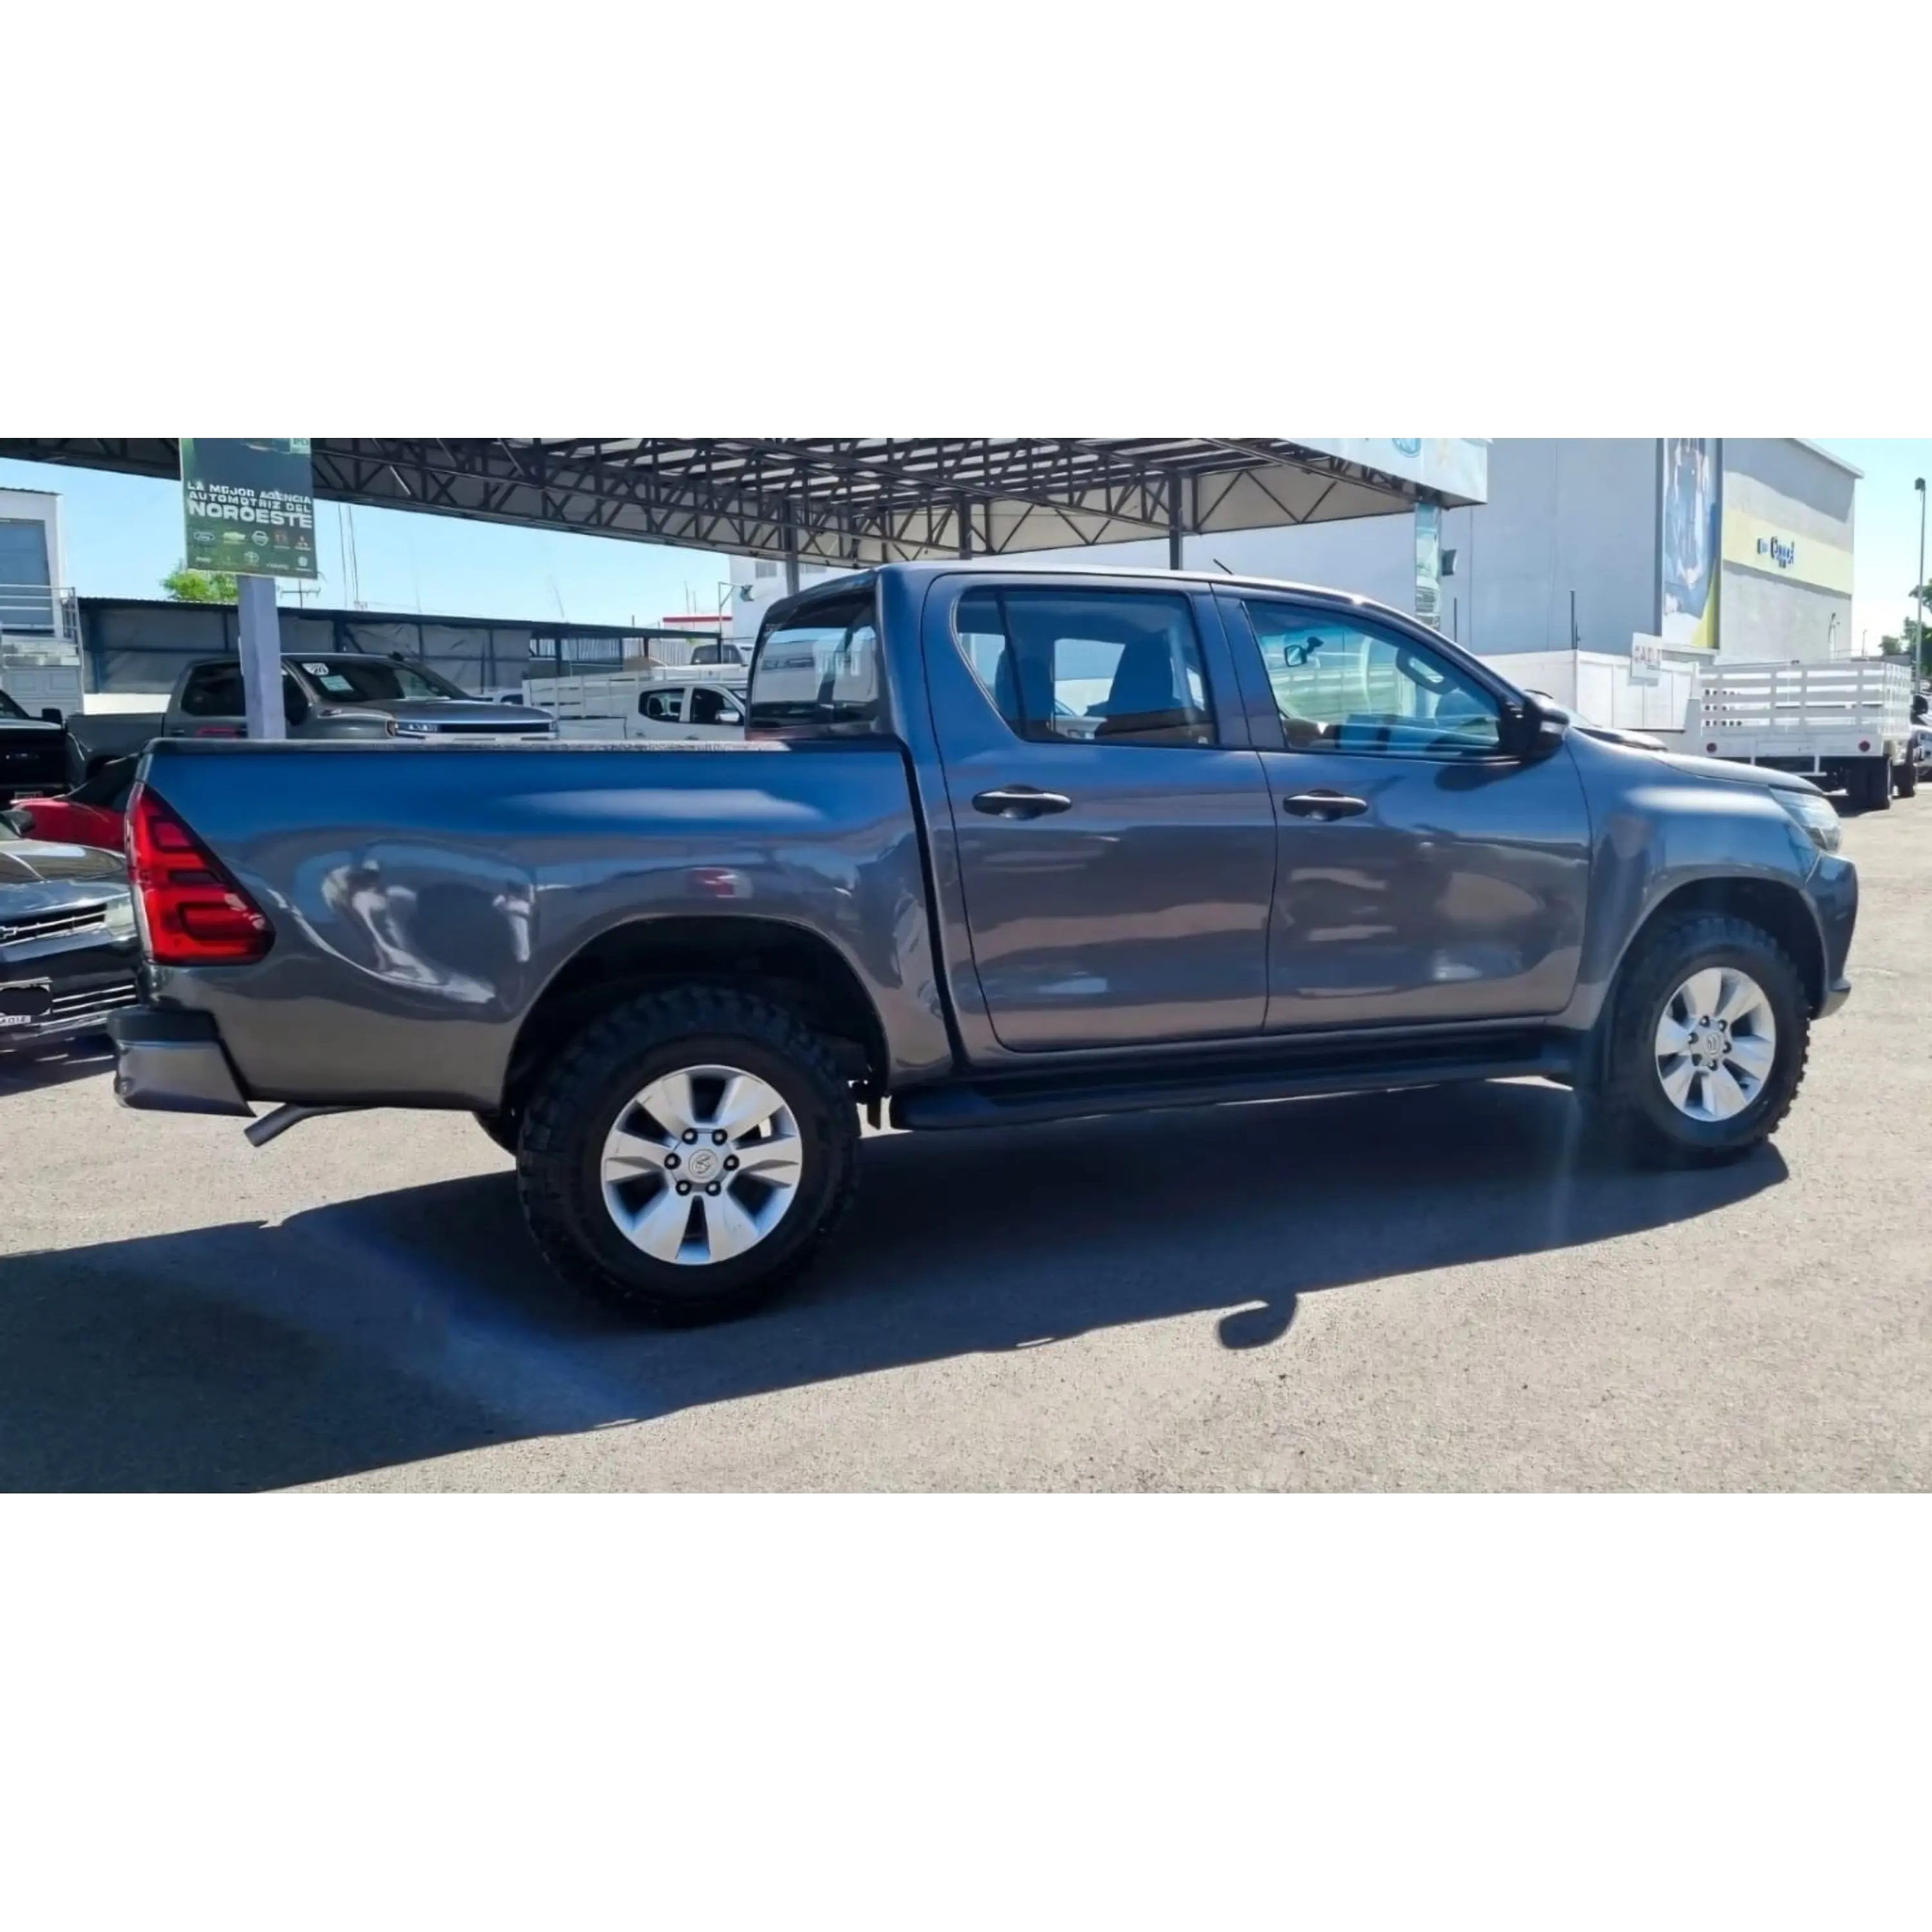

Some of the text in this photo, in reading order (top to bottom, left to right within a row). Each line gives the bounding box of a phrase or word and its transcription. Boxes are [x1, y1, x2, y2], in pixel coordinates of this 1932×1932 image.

[187, 482, 205, 491] LA
[209, 484, 254, 497] MEJOR
[189, 491, 311, 513] AUTOMOTRIZ DEL
[187, 500, 312, 528] NOROESTE
